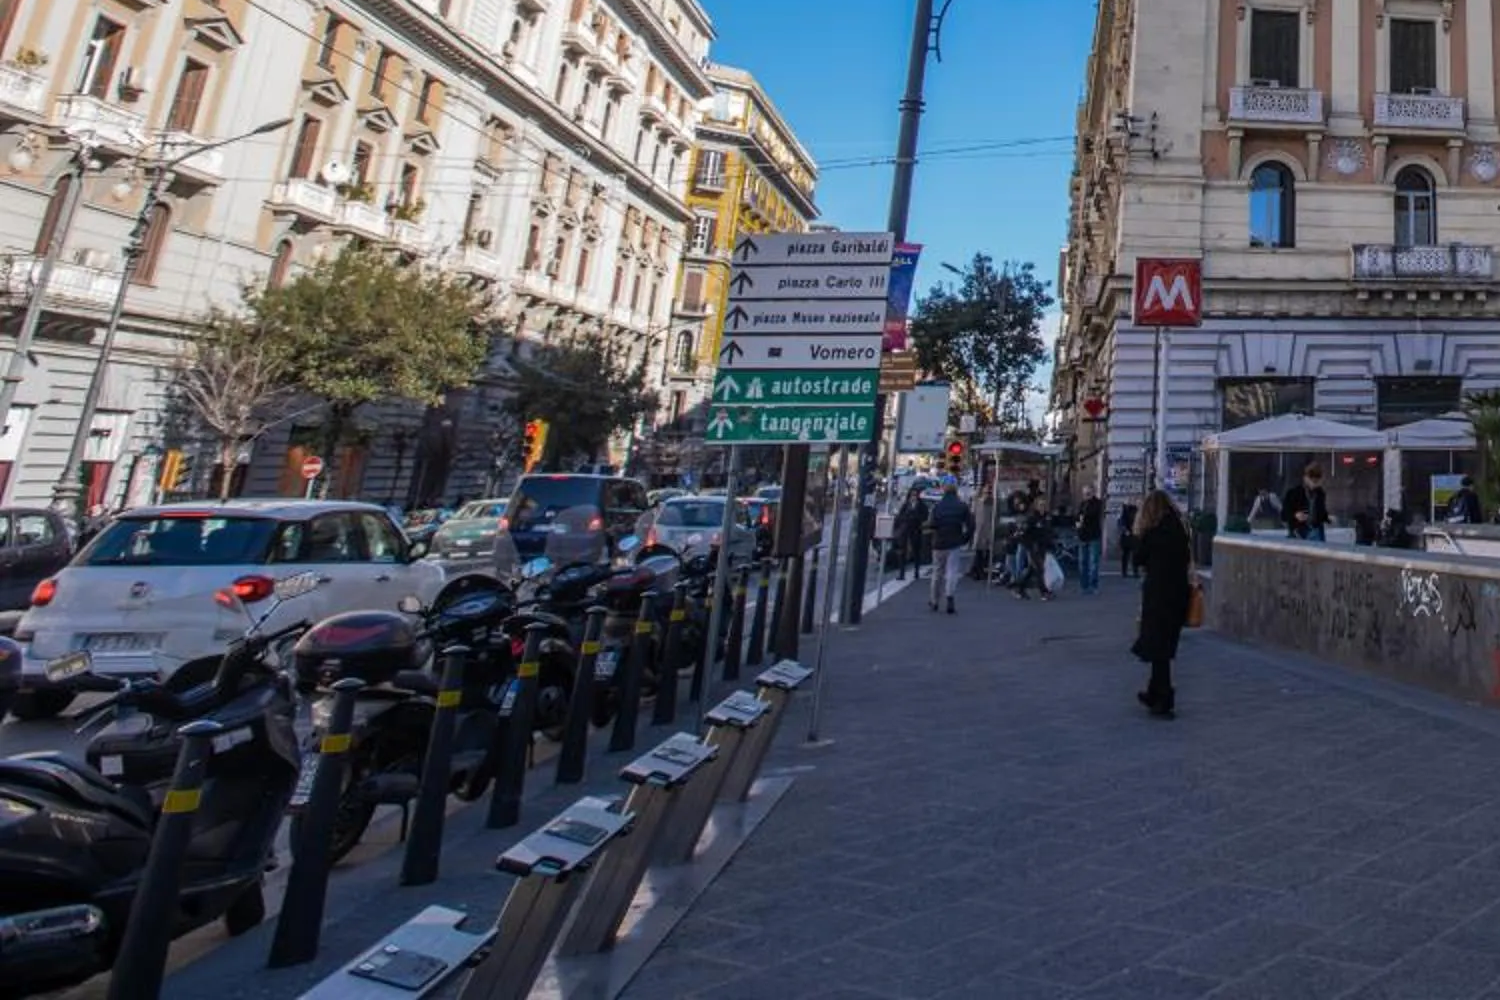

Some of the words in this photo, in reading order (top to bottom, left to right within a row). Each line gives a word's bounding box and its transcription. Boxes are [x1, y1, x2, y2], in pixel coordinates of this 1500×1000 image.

[787, 241, 825, 256] piazza
[832, 240, 889, 254] Garibaldi
[777, 276, 820, 290] piazza
[826, 275, 863, 289] Carlo
[1143, 274, 1196, 312] M
[752, 311, 787, 326] piazza
[810, 343, 876, 361] Vomero
[771, 376, 872, 395] autostrade
[760, 411, 868, 435] tangenziale
